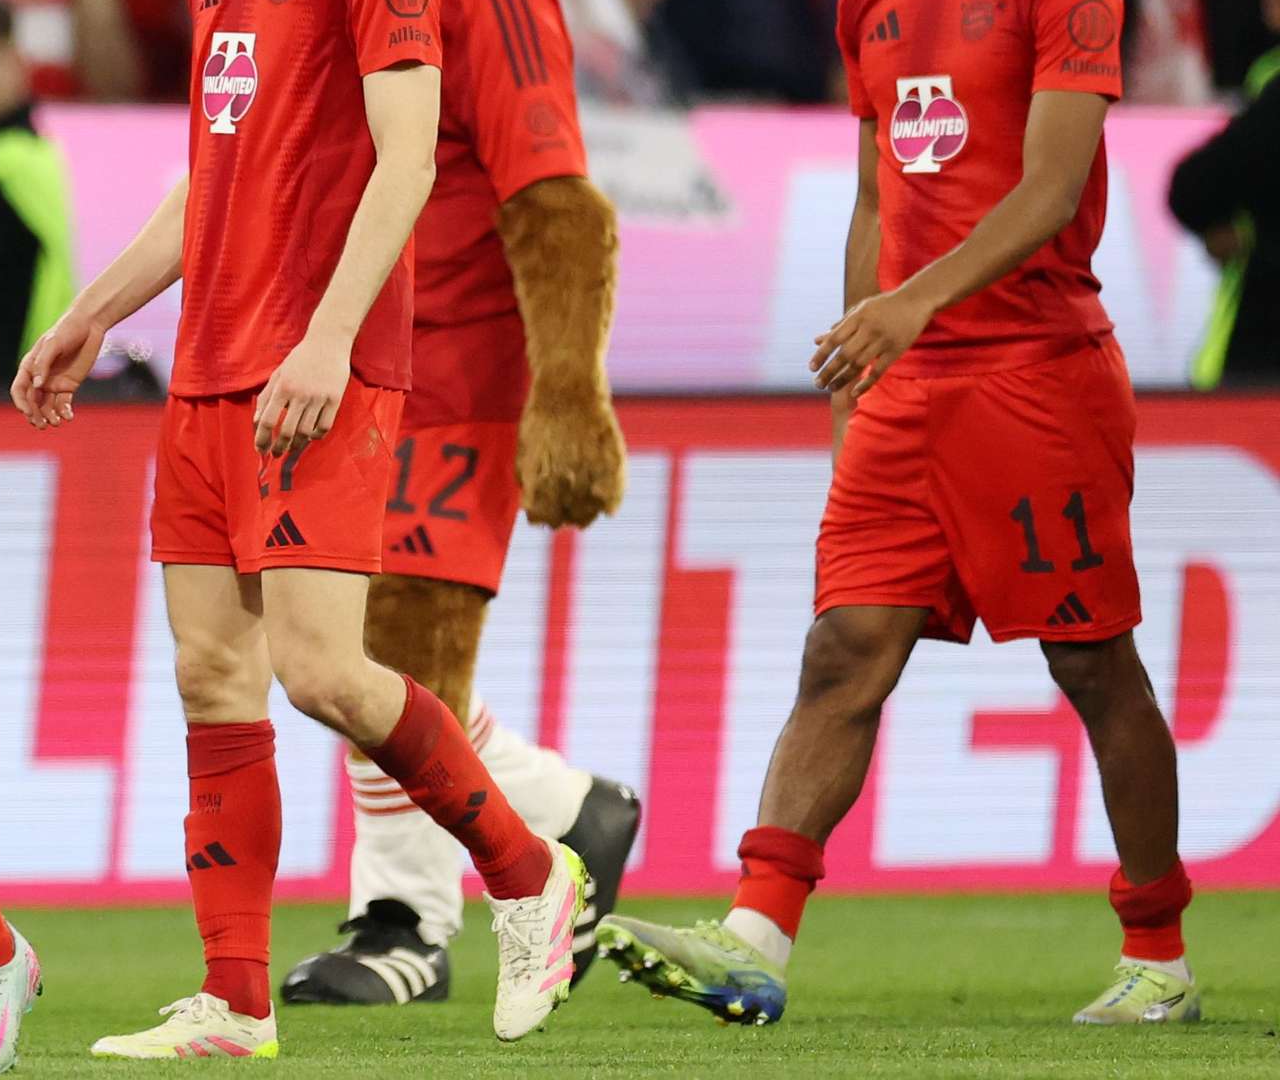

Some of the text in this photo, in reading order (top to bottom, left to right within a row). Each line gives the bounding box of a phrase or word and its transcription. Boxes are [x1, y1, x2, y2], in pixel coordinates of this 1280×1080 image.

[388, 26, 432, 48] Allianz
[203, 76, 254, 95] UNLIMITED
[893, 118, 963, 140] UNLIMITED
[387, 437, 480, 521] 12
[1010, 491, 1105, 573] 11
